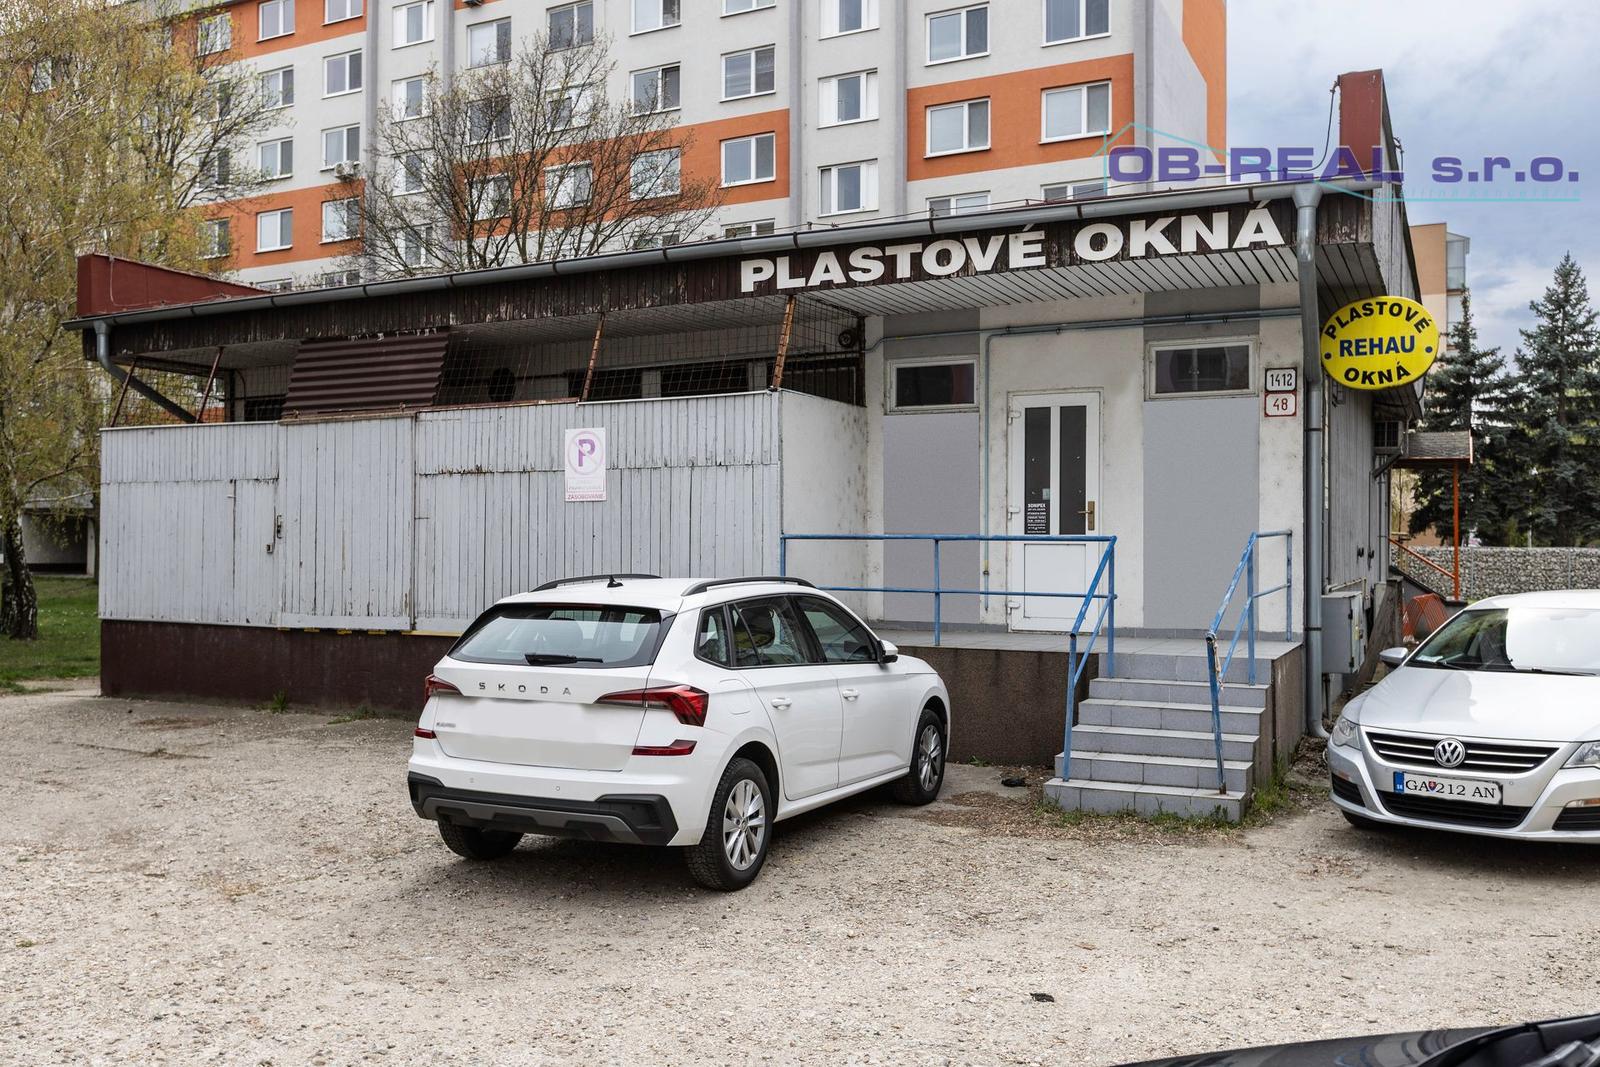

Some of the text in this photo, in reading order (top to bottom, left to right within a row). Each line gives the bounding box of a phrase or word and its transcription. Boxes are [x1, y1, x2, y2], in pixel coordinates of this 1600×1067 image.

[740, 199, 1285, 293] PLASTOVÉ OKNÁ
[1325, 302, 1432, 340] PLASTOVÉ
[1339, 335, 1415, 357] REHAU
[1270, 373, 1293, 387] 1412
[1344, 361, 1411, 385] OKNÁ
[1273, 398, 1288, 411] 48
[1405, 780, 1496, 798] GA 212 AN
